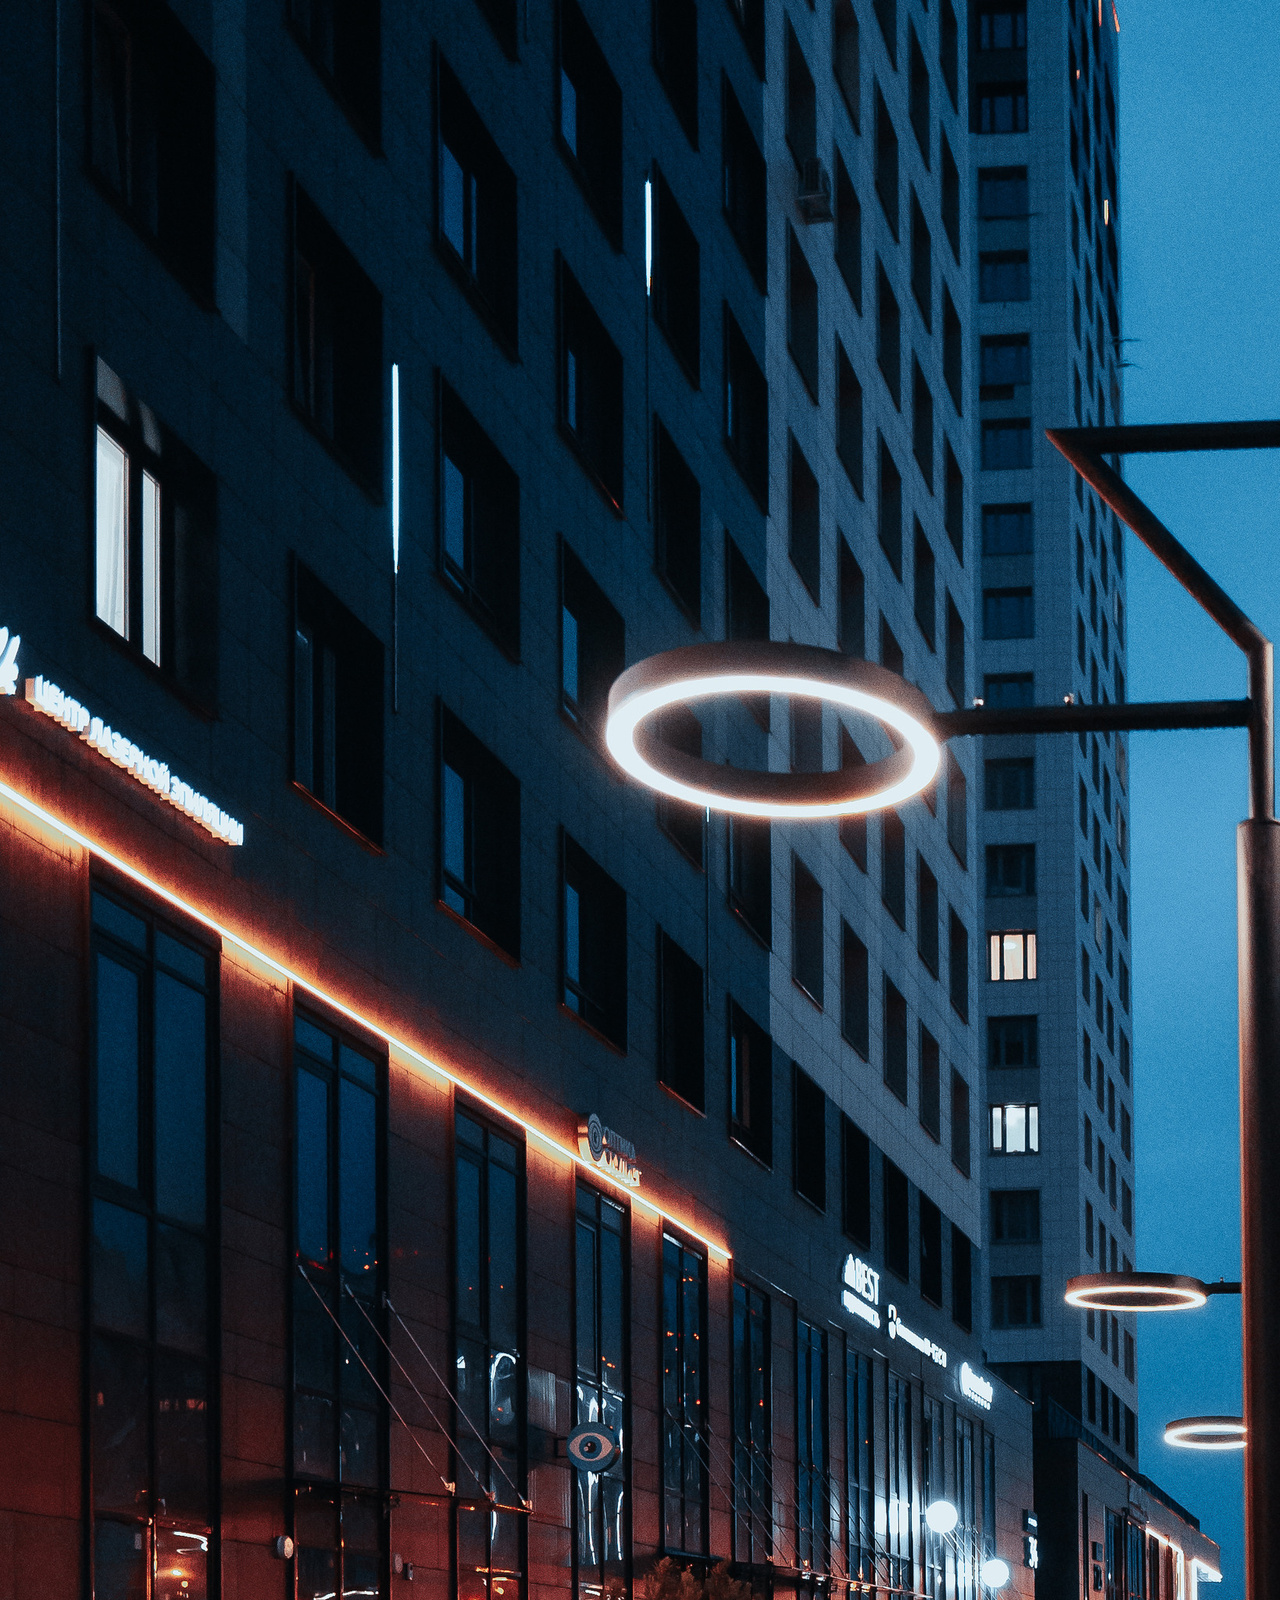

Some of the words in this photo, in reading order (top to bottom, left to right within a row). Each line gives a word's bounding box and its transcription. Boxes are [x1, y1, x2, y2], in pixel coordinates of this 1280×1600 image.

[34, 674, 90, 732] ЦЕНТР
[89, 716, 171, 794] ЛАЗЕРНОЙ
[855, 1258, 880, 1305] BEST
